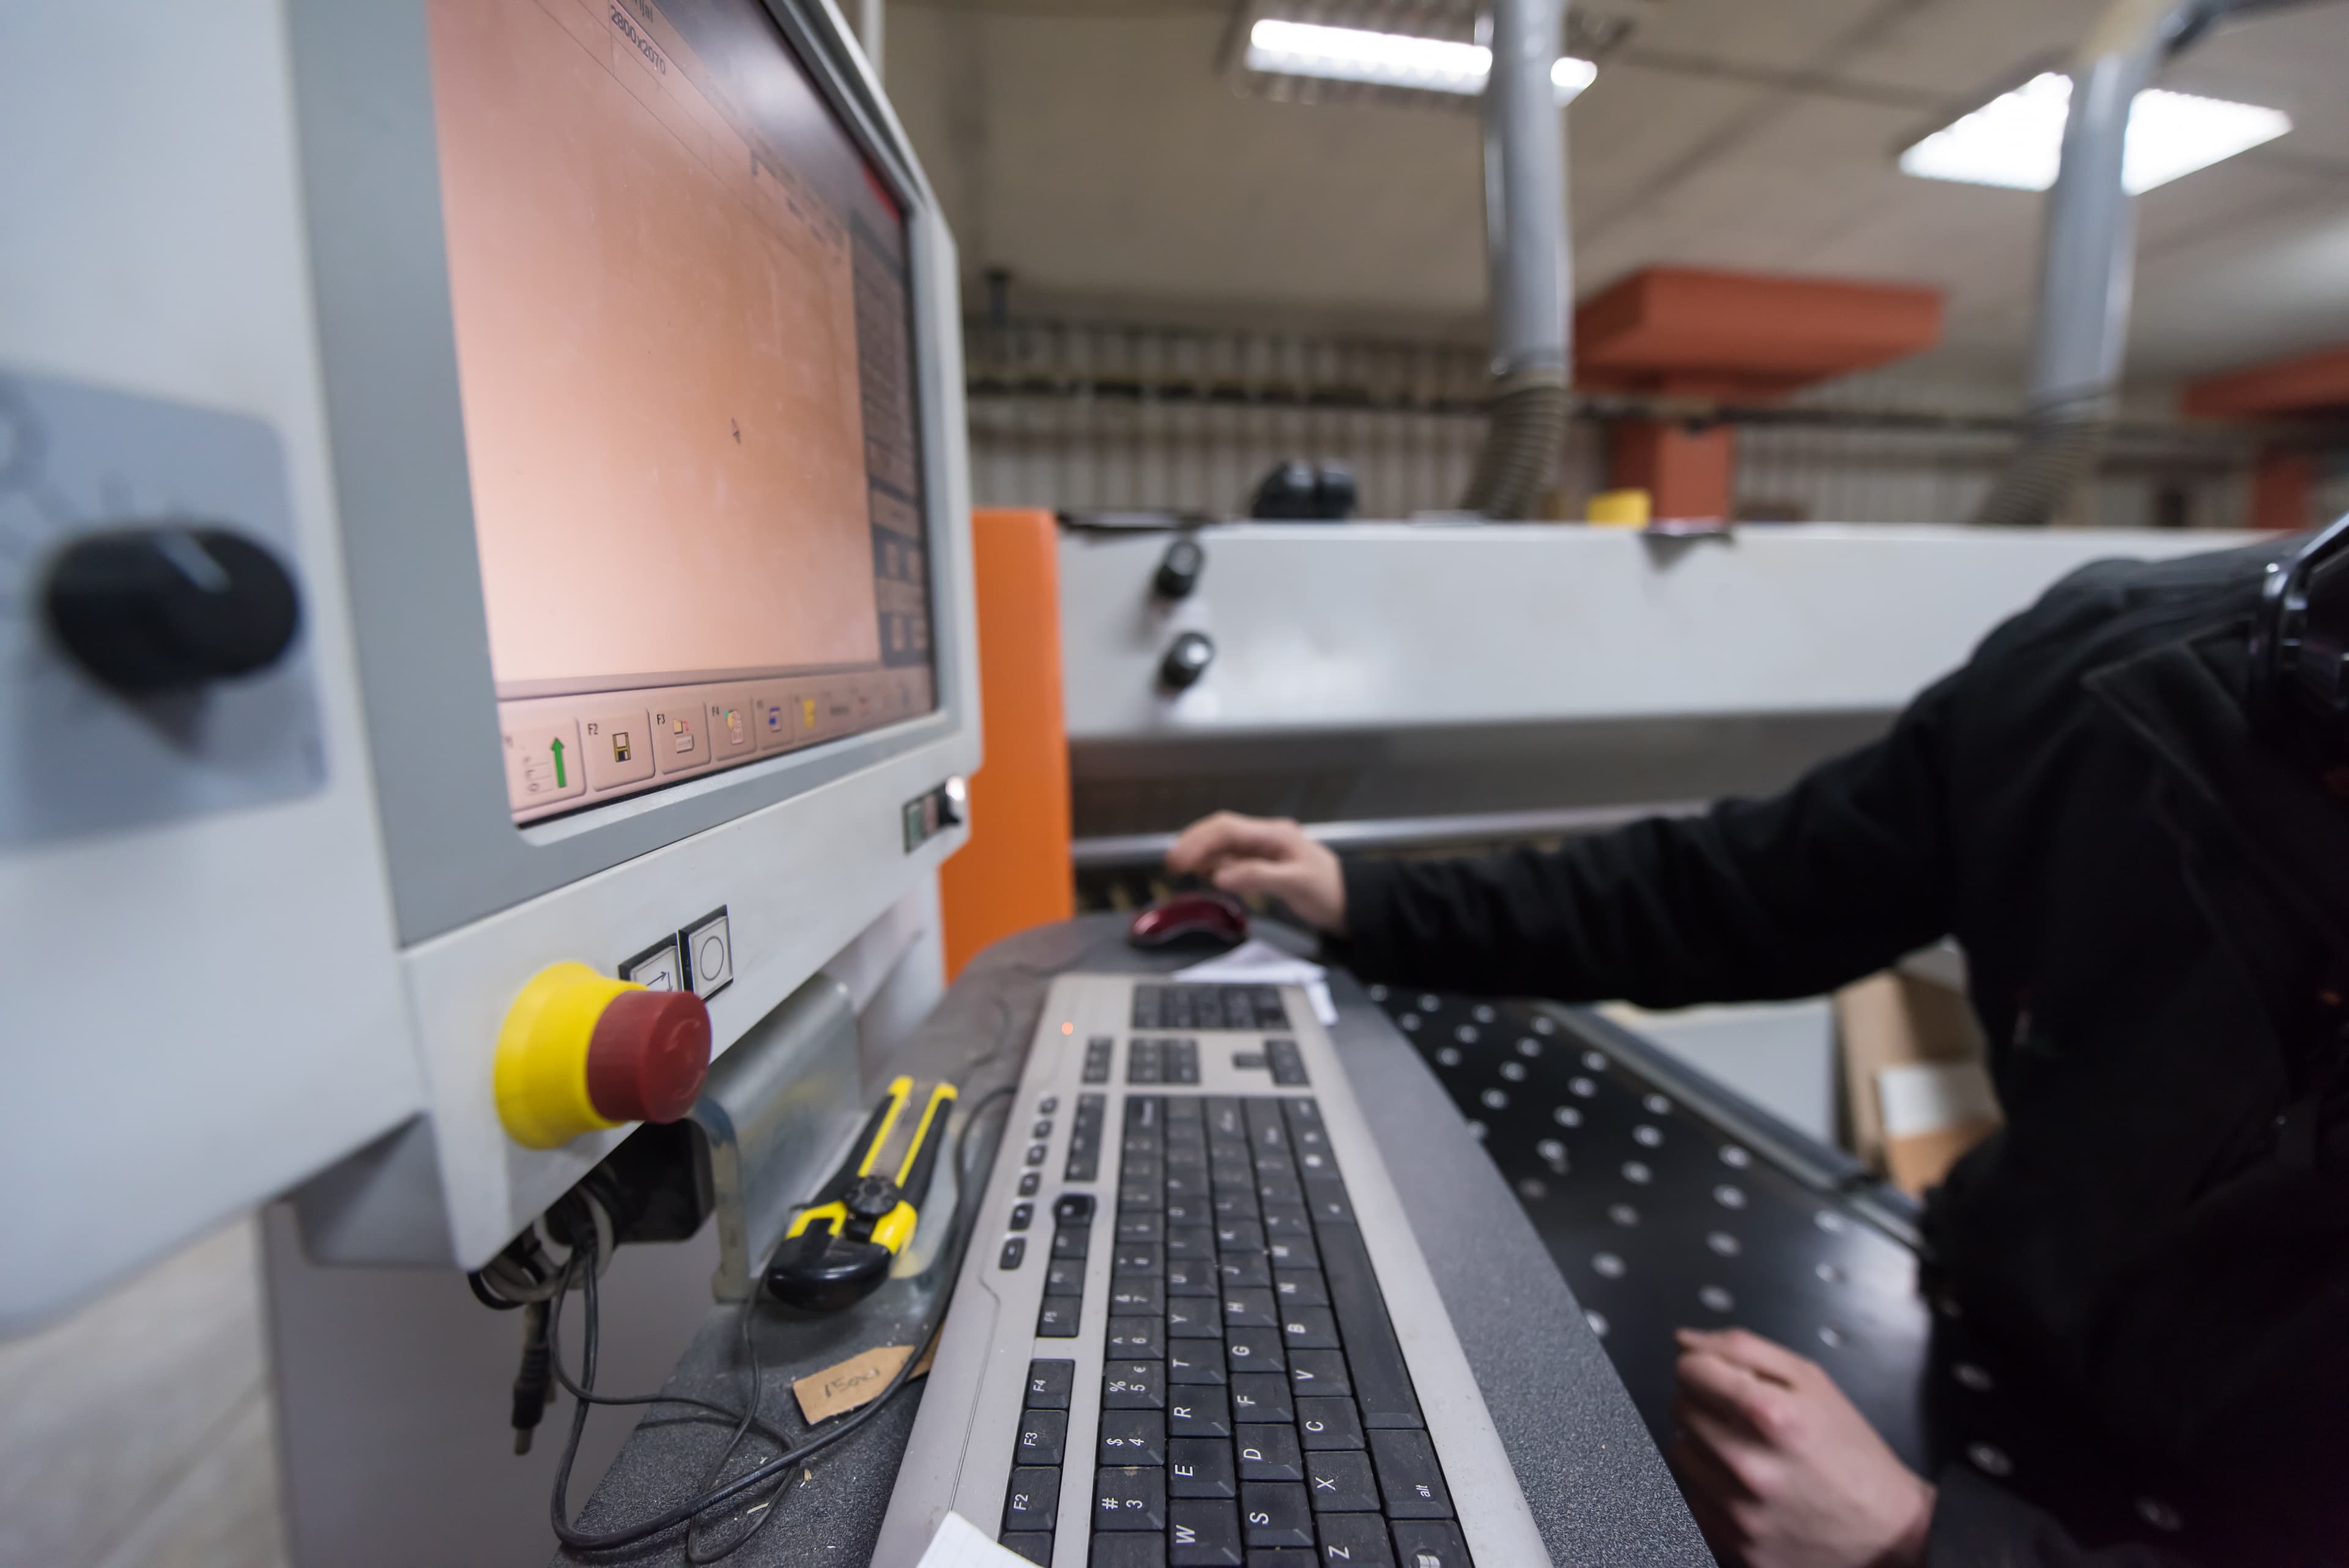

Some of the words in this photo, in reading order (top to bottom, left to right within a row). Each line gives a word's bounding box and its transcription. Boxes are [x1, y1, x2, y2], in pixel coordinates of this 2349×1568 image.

[610, 4, 666, 75] 2800x2070
[711, 706, 720, 716] F4
[656, 714, 666, 726] F3
[587, 723, 599, 735] F2
[1171, 1274, 1187, 1284] U
[1280, 1282, 1296, 1293] N
[1227, 1302, 1244, 1312] H
[1044, 1310, 1057, 1322] F5
[1171, 1313, 1188, 1323] Y
[1287, 1323, 1305, 1334] B
[1231, 1345, 1250, 1356] G
[1173, 1359, 1190, 1367] T
[1296, 1369, 1315, 1380] V
[1033, 1379, 1047, 1392] F4
[1109, 1380, 1126, 1392] %
[1237, 1394, 1256, 1405] F
[1174, 1406, 1192, 1418] R
[1305, 1421, 1324, 1432] C
[1023, 1432, 1038, 1447] F3
[1106, 1438, 1124, 1447] $
[1128, 1438, 1145, 1447] 4
[1243, 1448, 1262, 1460] D
[1174, 1464, 1193, 1477] E
[1315, 1476, 1337, 1492] X
[1415, 1483, 1431, 1498] alt
[1013, 1493, 1028, 1511] F2
[1102, 1497, 1119, 1510] #
[1126, 1499, 1143, 1510] 3
[1249, 1512, 1269, 1525] S
[1176, 1524, 1196, 1544] W
[1328, 1545, 1350, 1561] Z
